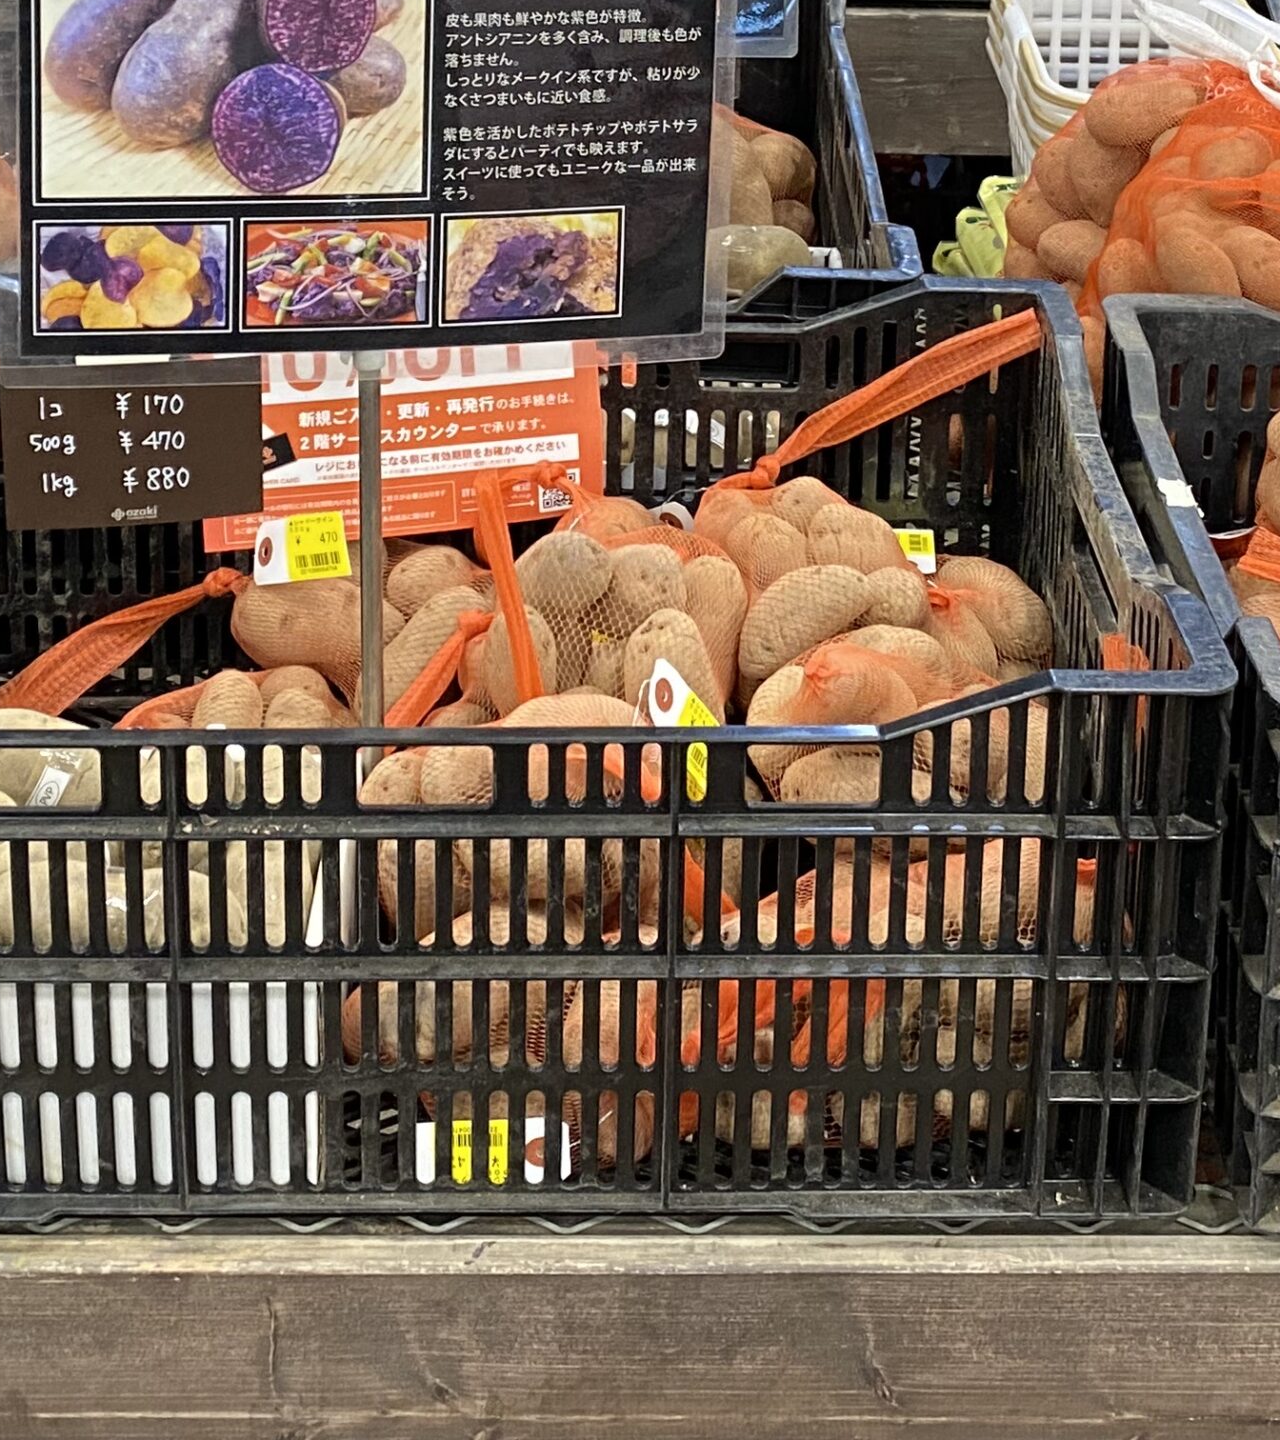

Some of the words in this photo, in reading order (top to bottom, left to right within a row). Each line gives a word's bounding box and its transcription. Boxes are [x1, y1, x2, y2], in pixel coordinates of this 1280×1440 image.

[445, 9, 647, 28] 皮も果肉も鮮やかな紫色が特徴。
[445, 27, 701, 48] アントシアニンを多く含み、調理後も色が
[444, 52, 519, 68] 落ちません。
[446, 67, 700, 88] しっとりなメークイン系ですが、粘りが少
[444, 88, 611, 107] なくさつまいもに近い食感。
[443, 119, 697, 142] 紫色を活かしたポテトチップやポテトサラ
[442, 158, 697, 181] スイーツに使ってもユニークな一品が出来
[442, 186, 475, 201] そう。
[29, 433, 77, 455] 500g
[42, 473, 78, 497] 1kg
[320, 532, 338, 543] 470
